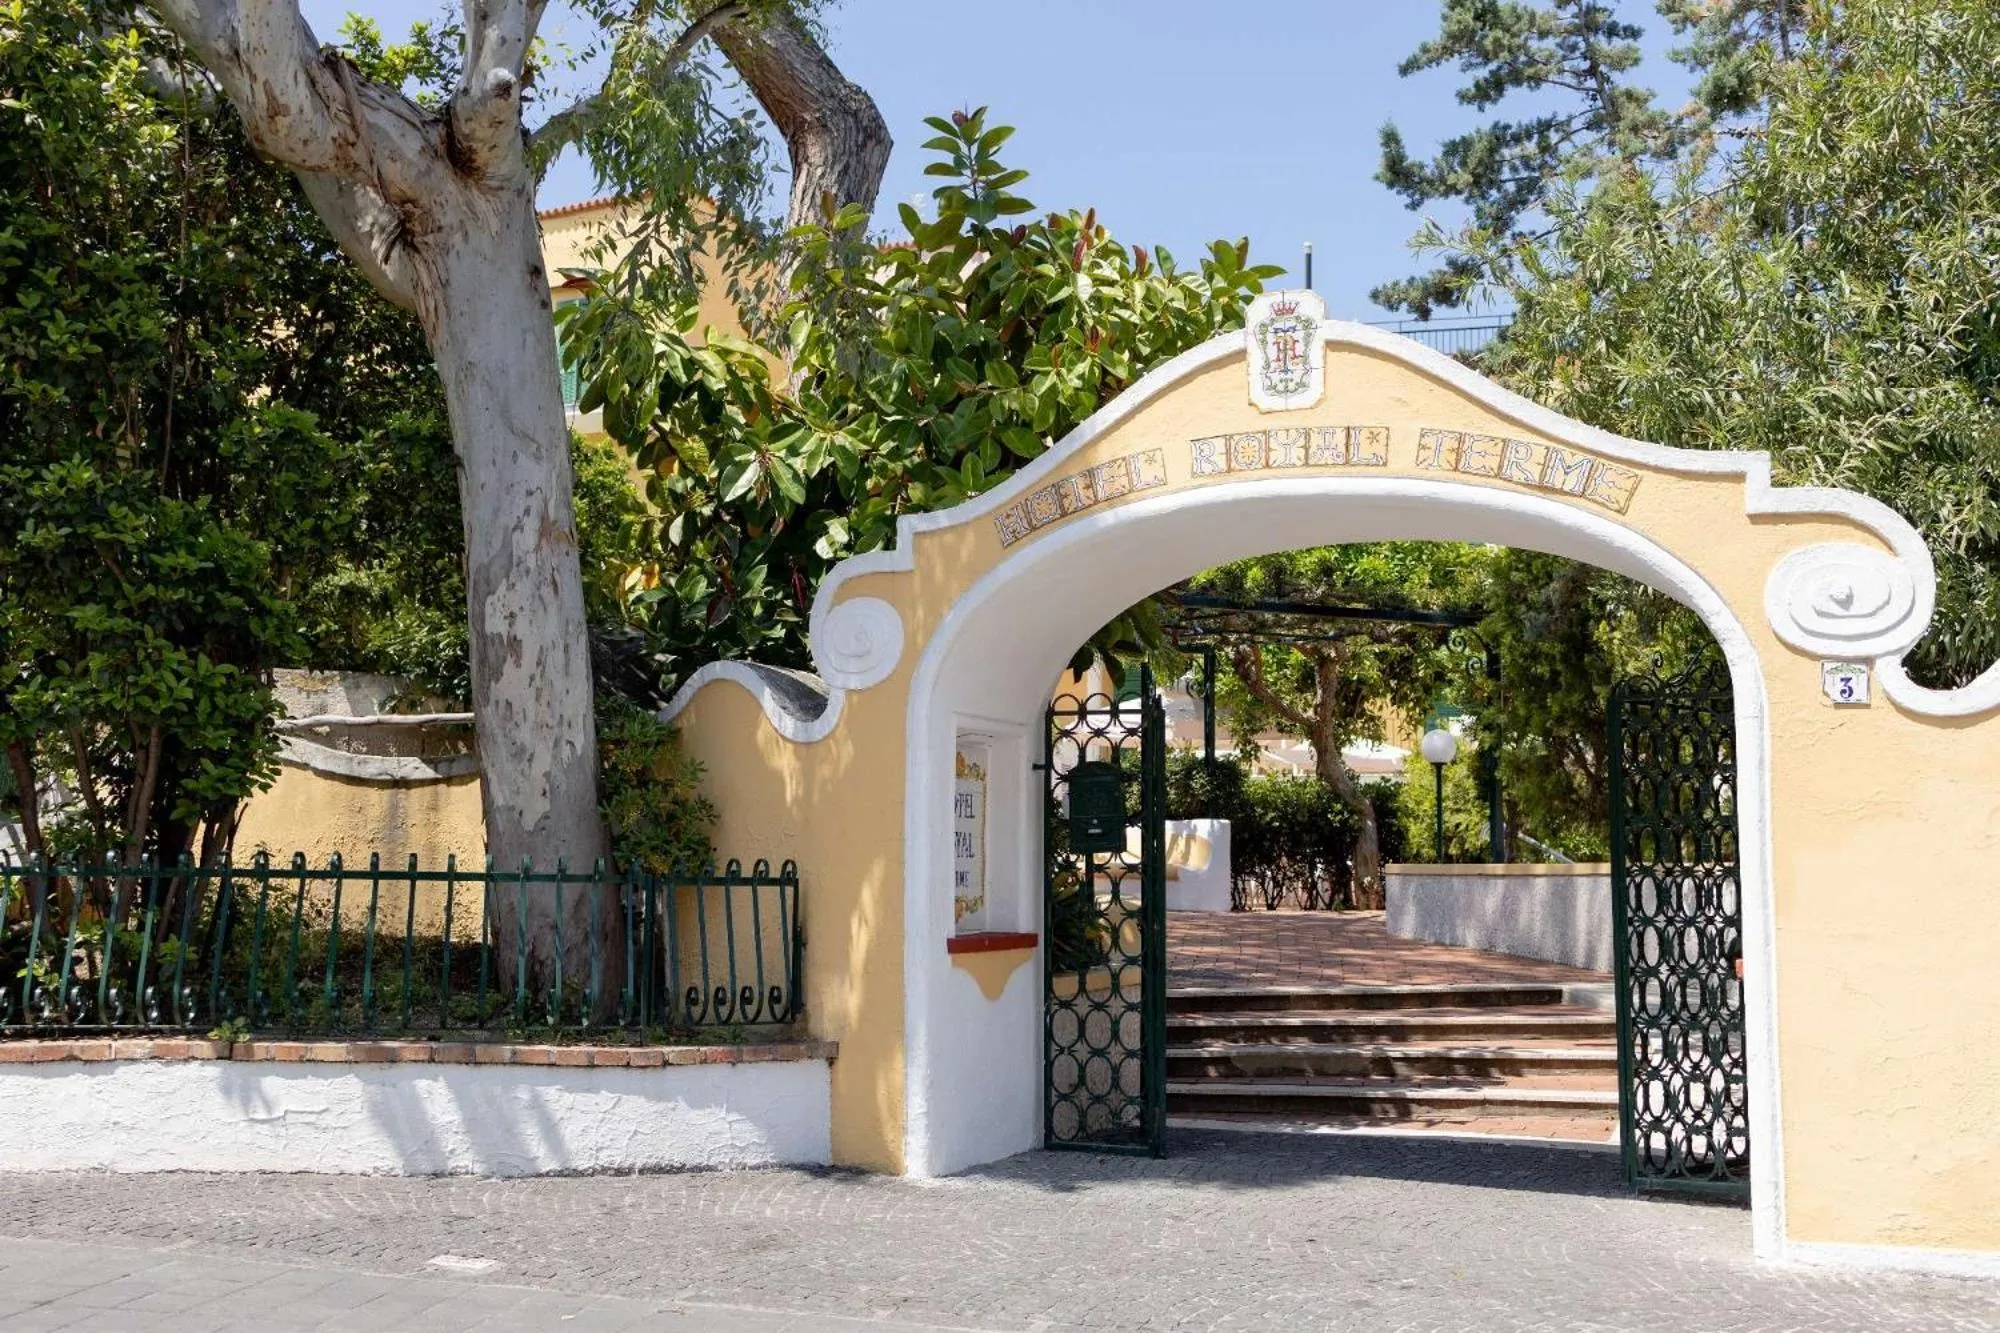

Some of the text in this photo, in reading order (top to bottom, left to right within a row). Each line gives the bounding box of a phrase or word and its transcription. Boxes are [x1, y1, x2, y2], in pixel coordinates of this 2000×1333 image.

[994, 426, 1638, 548] HOTEL ROYAL TERME
[1840, 676, 1854, 699] 3
